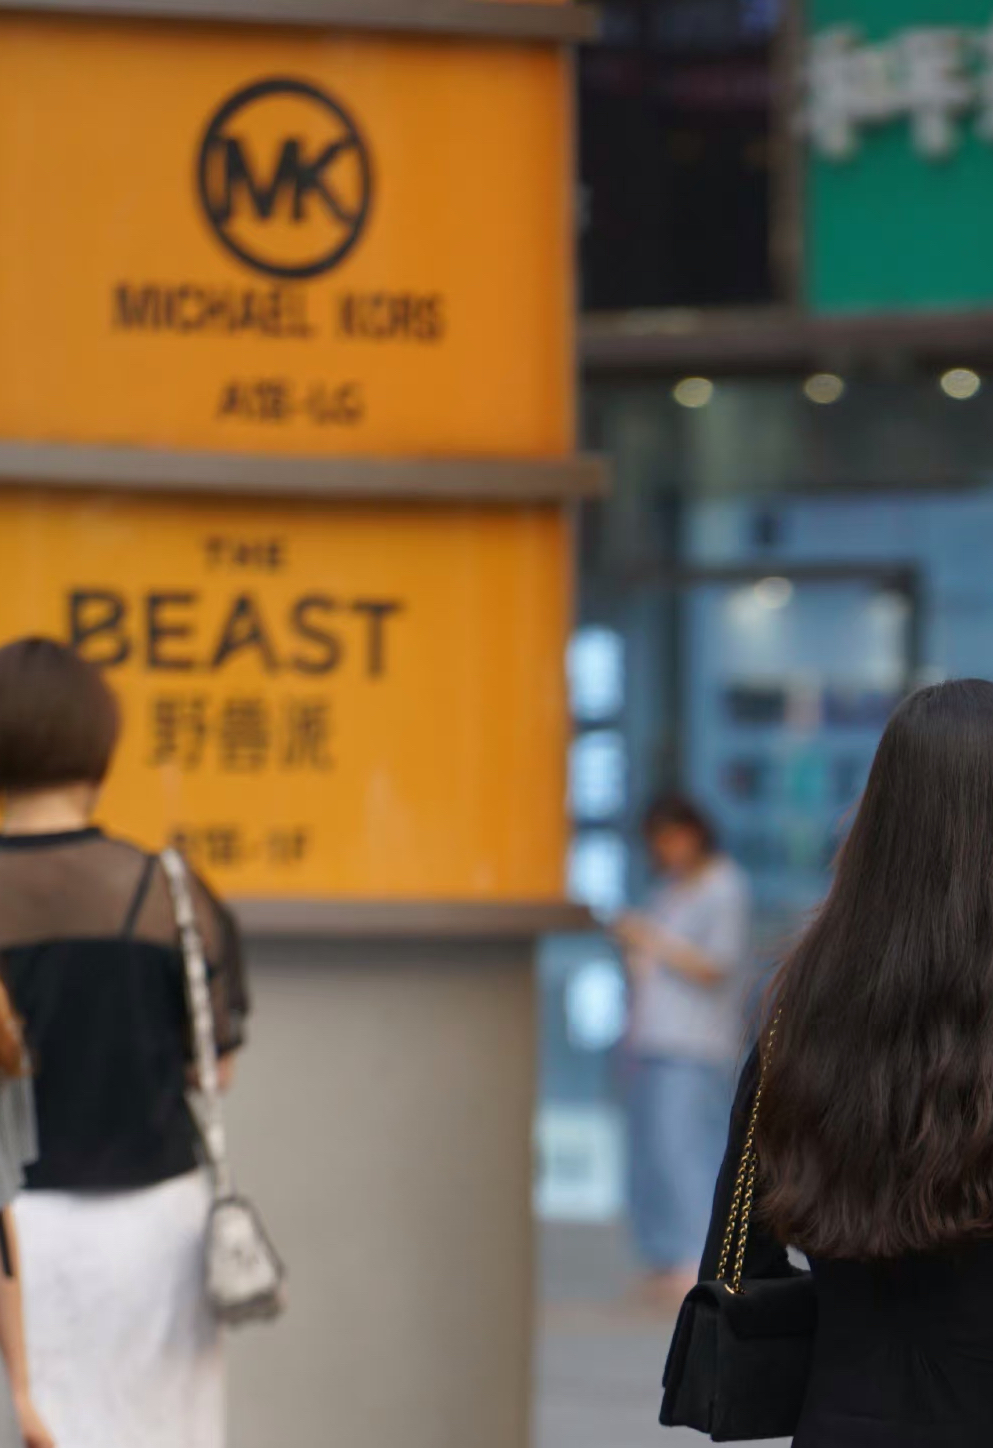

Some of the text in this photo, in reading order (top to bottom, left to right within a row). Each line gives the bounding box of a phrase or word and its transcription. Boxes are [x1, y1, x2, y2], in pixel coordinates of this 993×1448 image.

[113, 281, 443, 343] MICHAEL KORS
[205, 537, 287, 571] THE
[68, 589, 404, 678] BEAST
[150, 692, 334, 772] 野兽派
